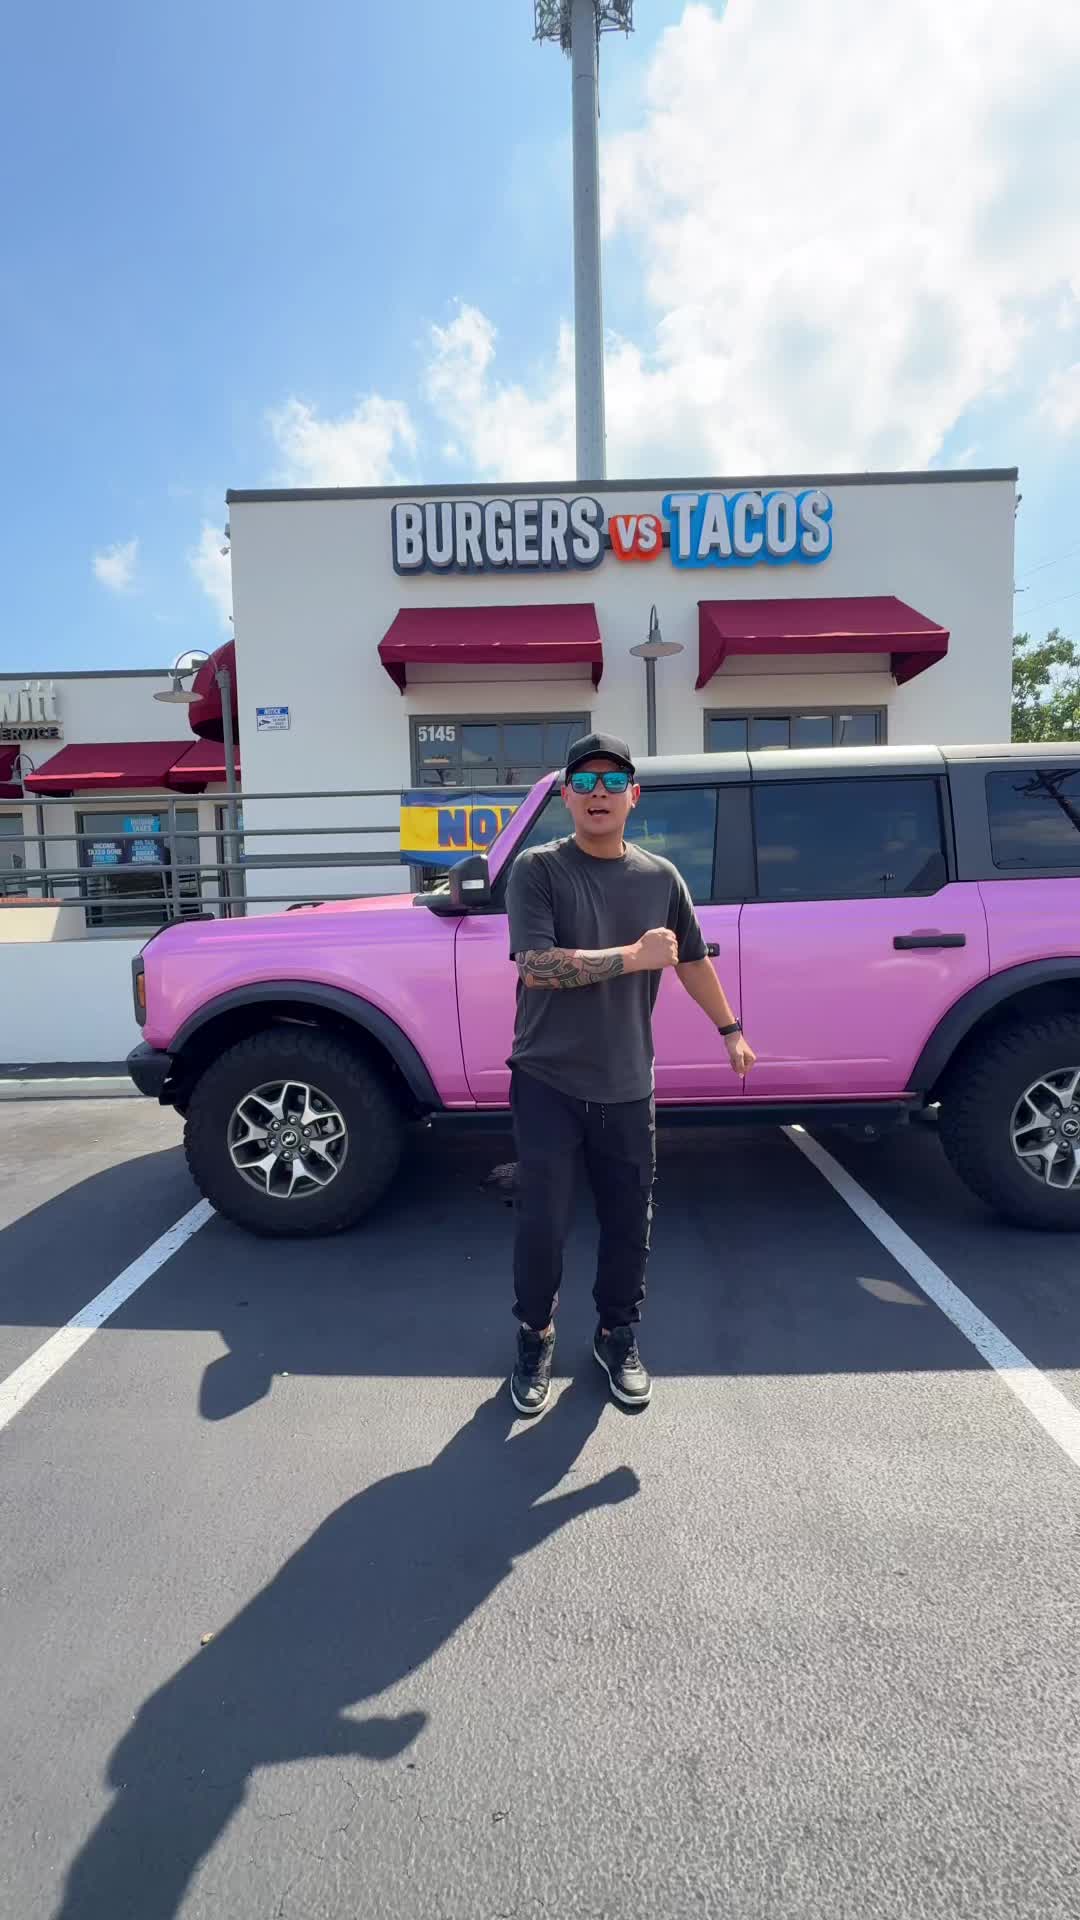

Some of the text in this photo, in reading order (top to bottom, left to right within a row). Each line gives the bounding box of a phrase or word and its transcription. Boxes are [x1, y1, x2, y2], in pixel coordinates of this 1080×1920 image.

[395, 491, 829, 568] BURGERS VS TACOS
[418, 725, 456, 742] 5145
